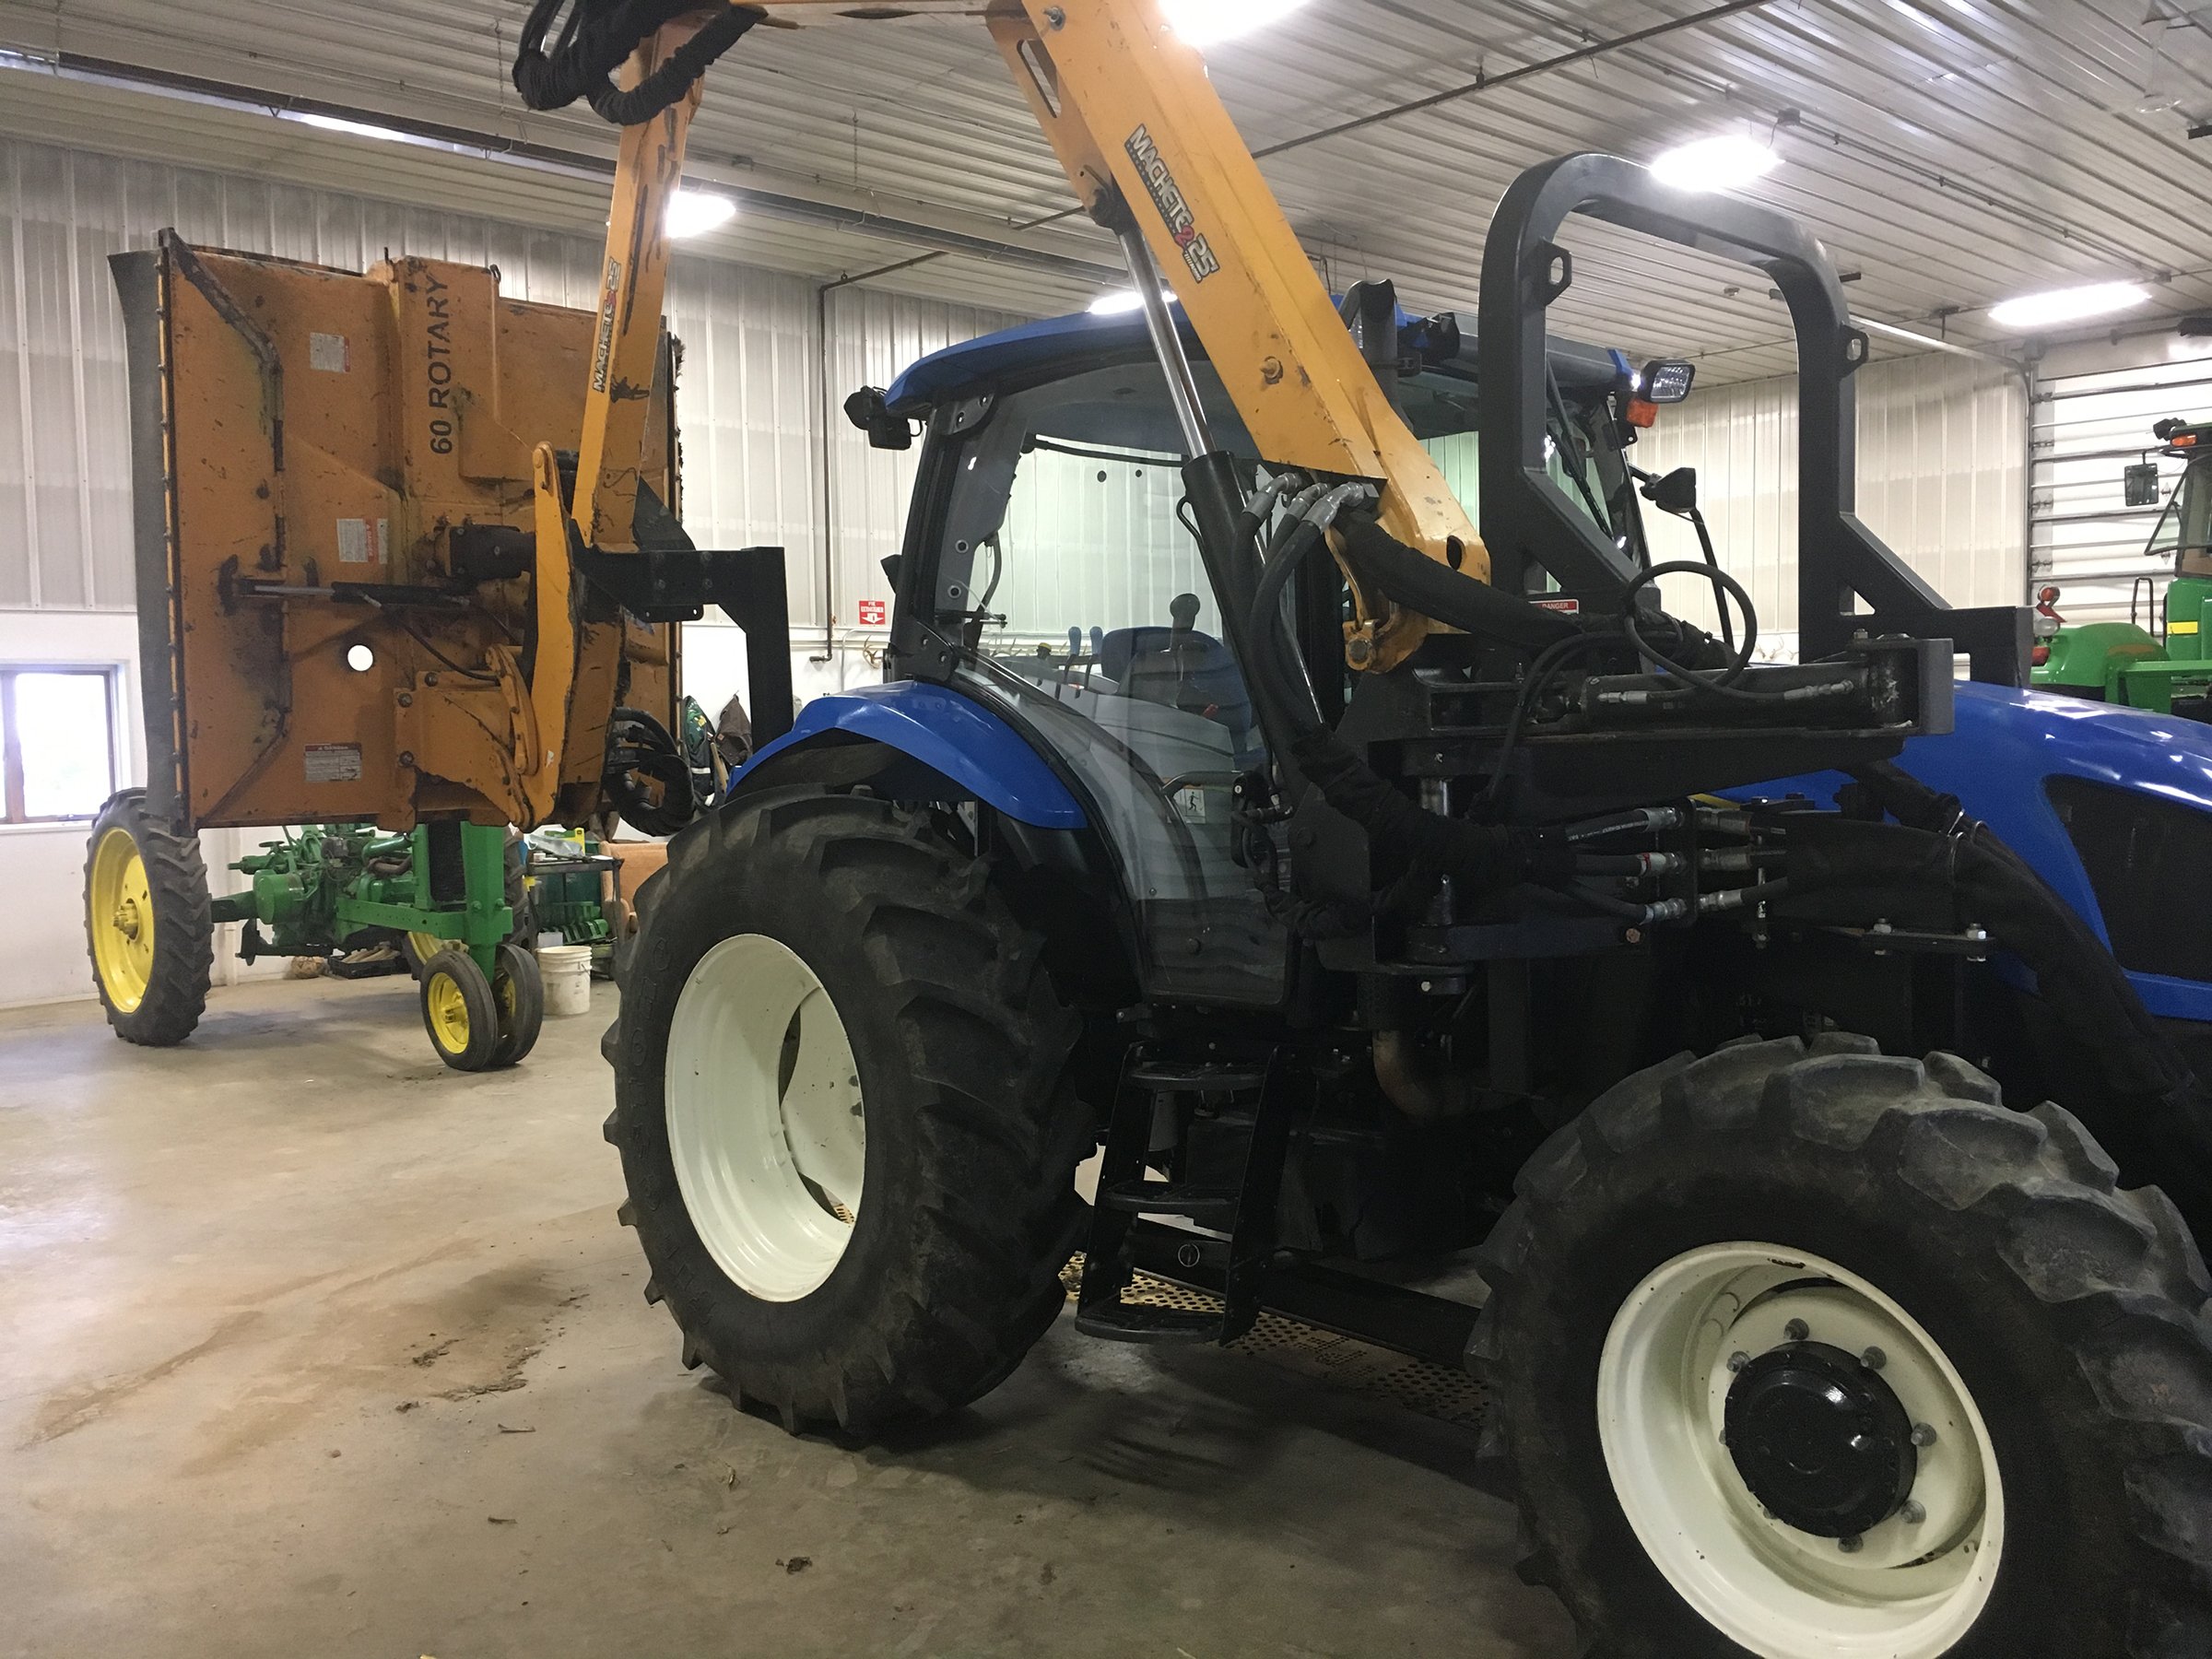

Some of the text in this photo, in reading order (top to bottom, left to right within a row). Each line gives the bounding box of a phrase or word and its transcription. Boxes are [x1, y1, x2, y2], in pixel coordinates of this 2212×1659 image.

[1128, 124, 1194, 233] MACHETE
[426, 274, 453, 454] 60 ROTARY
